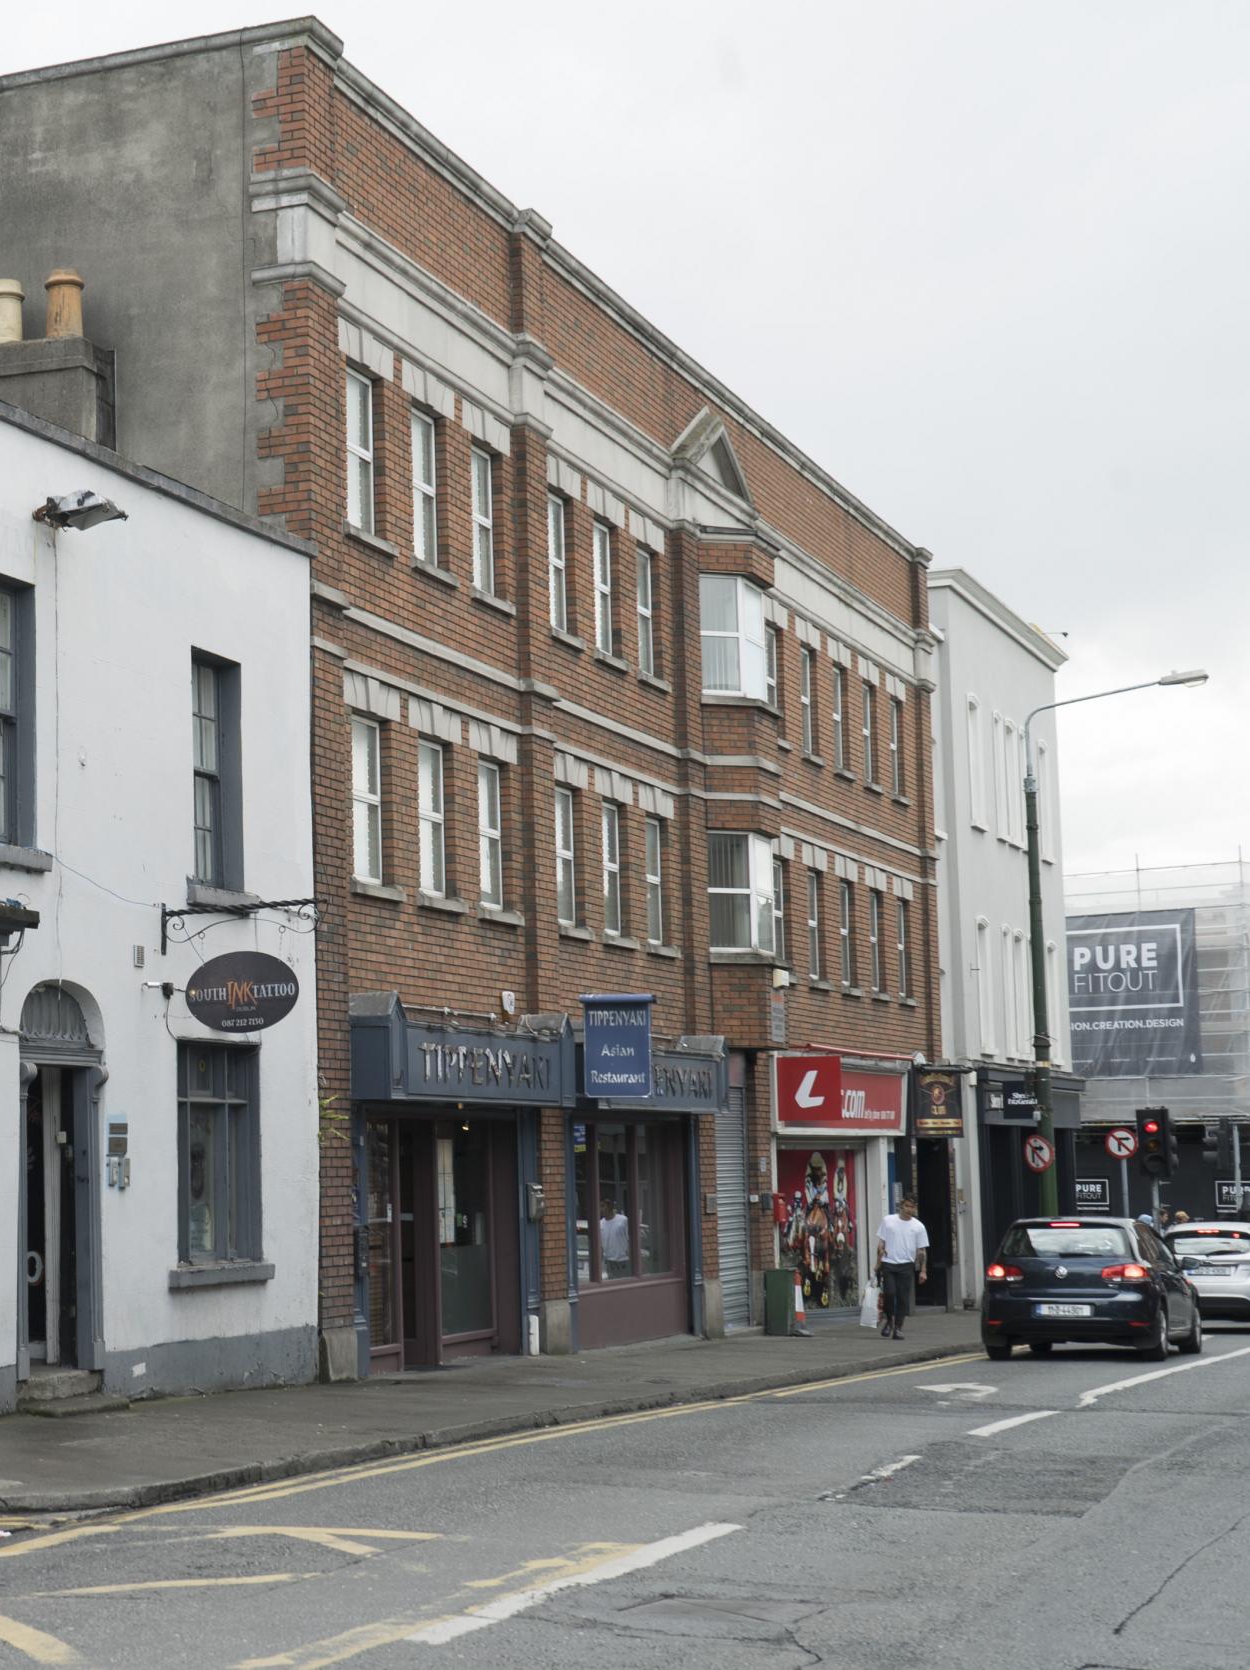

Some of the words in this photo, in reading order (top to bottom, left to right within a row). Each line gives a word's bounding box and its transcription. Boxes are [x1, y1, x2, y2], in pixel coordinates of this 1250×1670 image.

[1073, 942, 1158, 971] PURE
[1074, 970, 1158, 994] FITOUT
[190, 987, 227, 1002] SOUTH
[226, 980, 258, 1009] INK
[252, 982, 296, 998] TATTOO
[588, 1010, 646, 1027] TIPPENYAKI
[1069, 1018, 1184, 1031] ION.CREATION.DESIGN
[601, 1044, 635, 1057] Asian
[418, 1042, 550, 1091] TIPPENYAKI
[590, 1070, 646, 1084] Restaurant
[654, 1063, 713, 1100] ENYAKI
[1075, 1184, 1102, 1193] PURE
[1075, 1192, 1102, 1200] FITOUT
